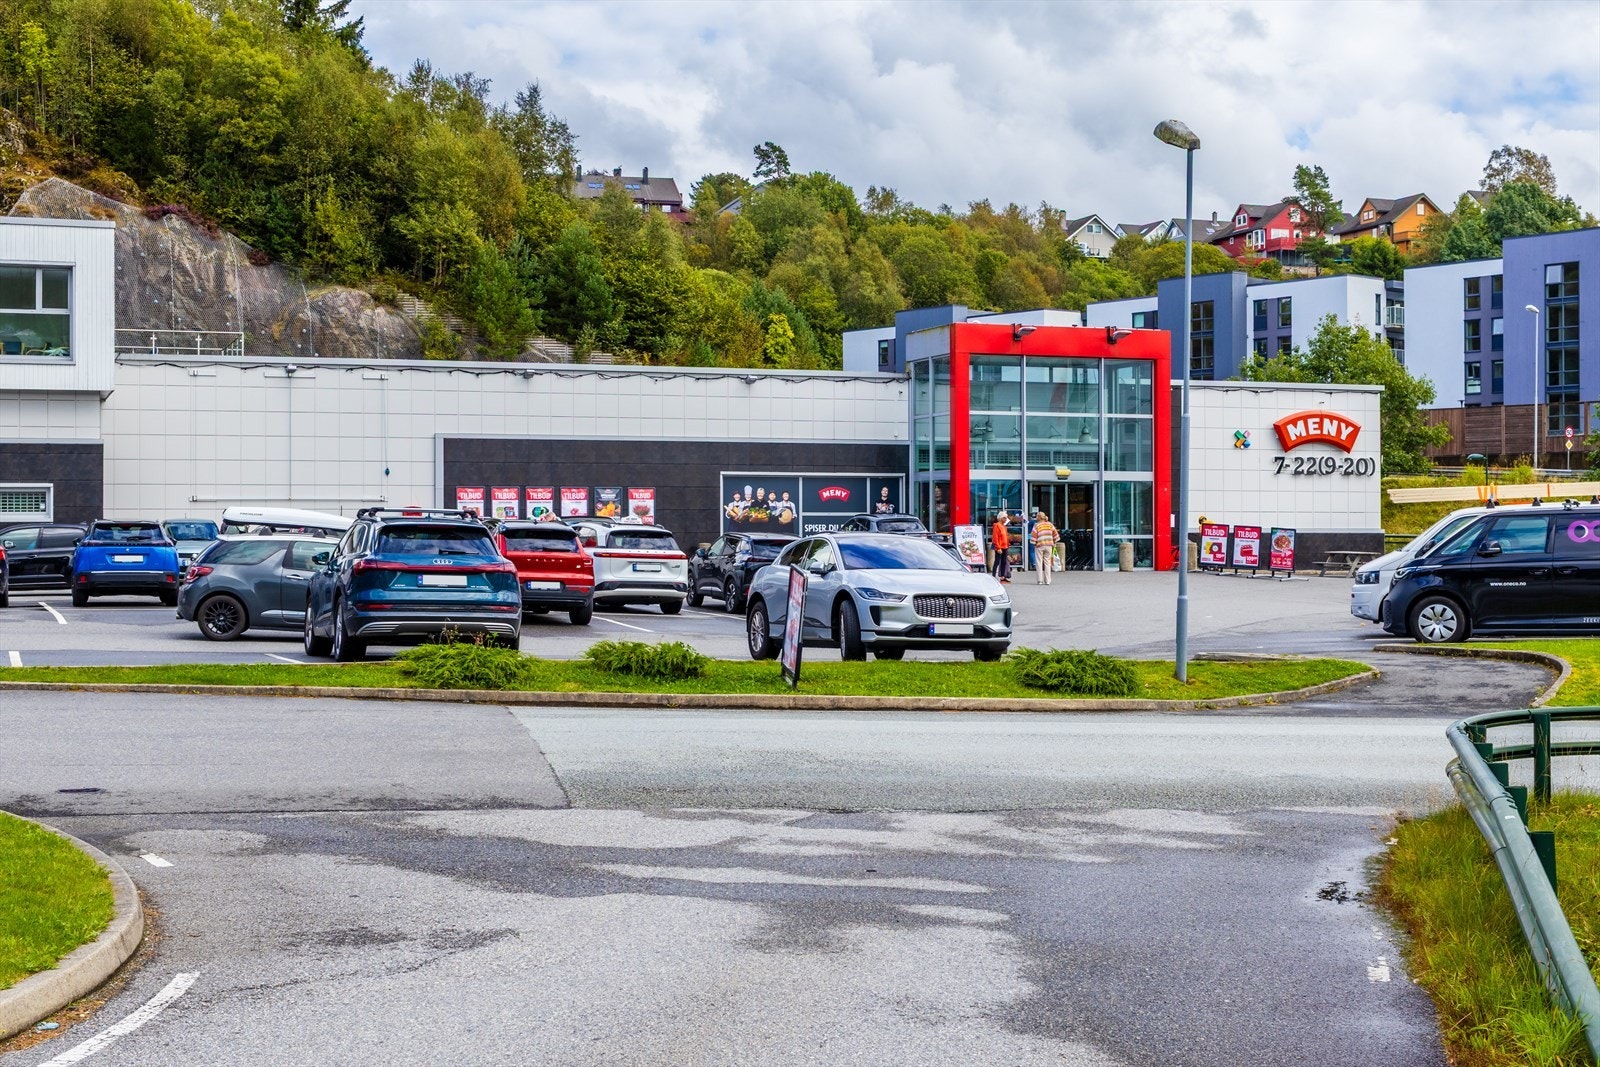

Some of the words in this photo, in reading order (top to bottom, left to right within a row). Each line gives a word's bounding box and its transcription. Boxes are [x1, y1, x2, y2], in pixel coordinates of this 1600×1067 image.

[1286, 417, 1354, 441] MENY
[1273, 456, 1376, 476] 7-22(9-20)
[460, 492, 482, 500] TILBUD
[495, 492, 516, 500] TILBUD
[529, 492, 552, 500] TILBUD
[563, 492, 586, 500] TILBUD
[822, 489, 847, 498] MENY
[804, 524, 826, 532] SPISER
[1204, 528, 1225, 536] TILBUD
[1237, 530, 1258, 538] TILBUD
